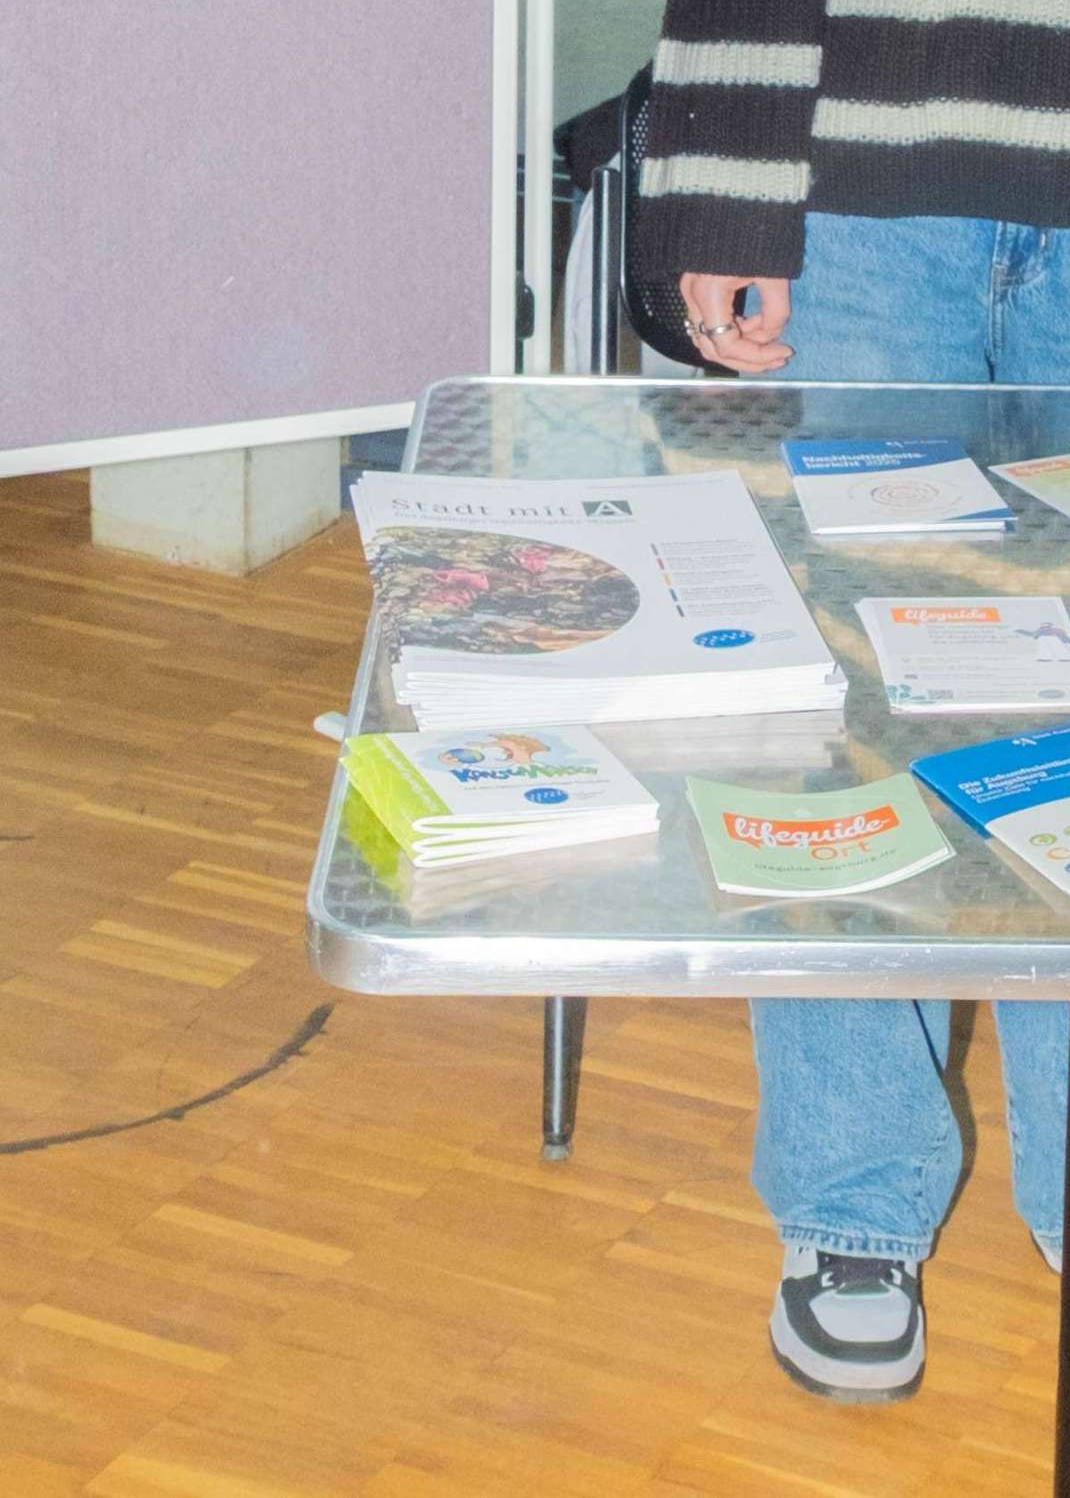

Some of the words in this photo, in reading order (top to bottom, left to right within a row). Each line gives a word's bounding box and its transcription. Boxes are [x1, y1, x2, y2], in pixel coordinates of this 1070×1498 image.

[391, 499, 490, 516] Stadt
[508, 504, 574, 517] mit
[590, 501, 629, 517] A
[811, 841, 871, 860] Ort
